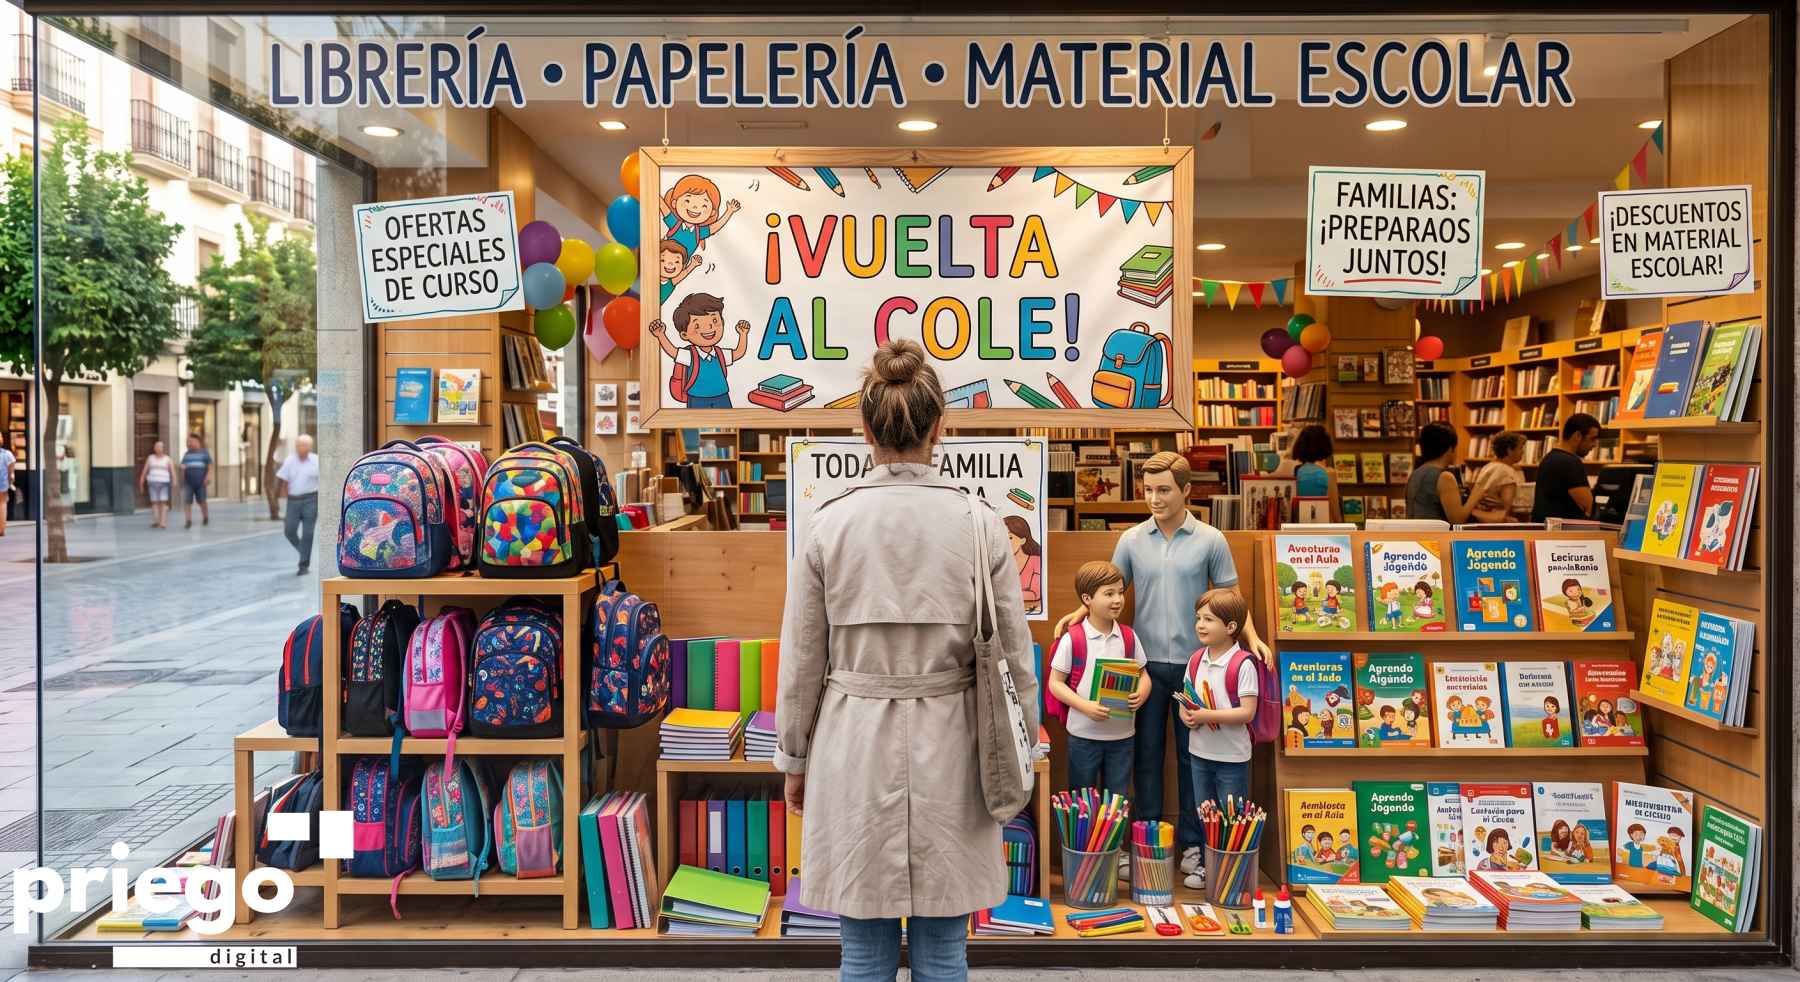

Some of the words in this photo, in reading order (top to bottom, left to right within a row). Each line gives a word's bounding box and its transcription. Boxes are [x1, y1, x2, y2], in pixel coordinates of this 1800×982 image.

[270, 25, 525, 106] LIBRERÍA
[583, 25, 907, 107] PAPELERÍA
[965, 41, 1275, 107] MATERIAL
[1299, 40, 1575, 107] ESCOLAR
[1337, 181, 1457, 210] FAMILIAS:
[385, 208, 486, 240] OFERTAS
[1321, 214, 1470, 245] ¡PREPARAOS
[1610, 200, 1742, 231] ¡DESCUENTOS
[371, 237, 506, 272] ESPECIALES
[765, 212, 1059, 285] ¡VUELTA
[1612, 233, 1637, 253] EN
[1645, 228, 1741, 252] MATERIAL
[1342, 248, 1446, 276] JUNTOS!
[1631, 254, 1723, 279] ESCOLAR!
[385, 276, 415, 302] DE
[423, 269, 499, 299] CURSO
[757, 296, 848, 360] AL
[874, 293, 1080, 361] COLE!
[1316, 555, 1339, 563] Aula
